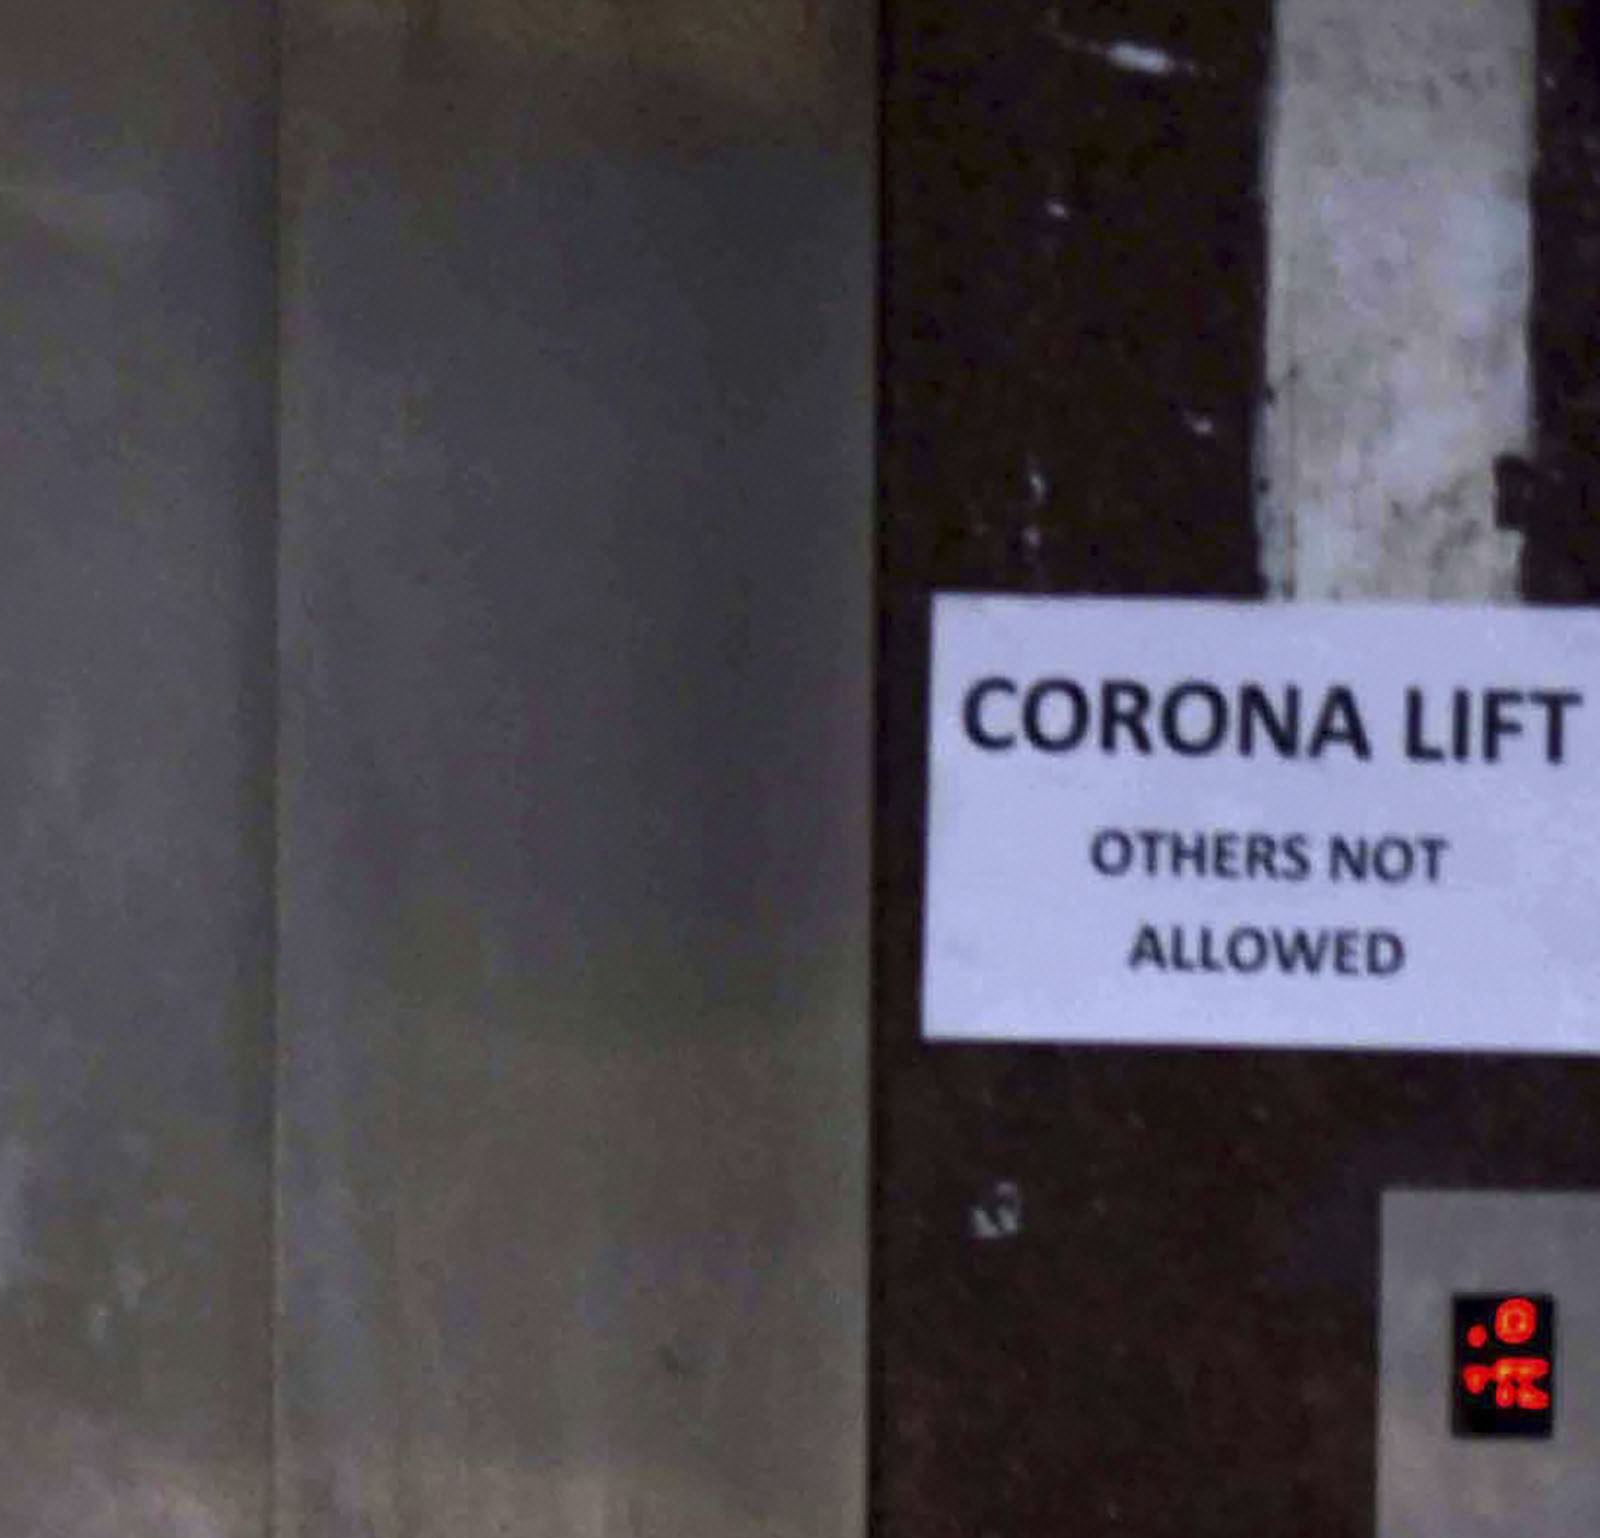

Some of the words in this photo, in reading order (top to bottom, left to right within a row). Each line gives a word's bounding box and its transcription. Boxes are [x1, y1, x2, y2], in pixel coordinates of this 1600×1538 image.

[960, 674, 1373, 763] CORONA
[1402, 684, 1584, 766] LIFT
[1088, 827, 1312, 882] OTHERS
[1327, 834, 1450, 884] NOT
[1127, 923, 1407, 976] ALLOWED
